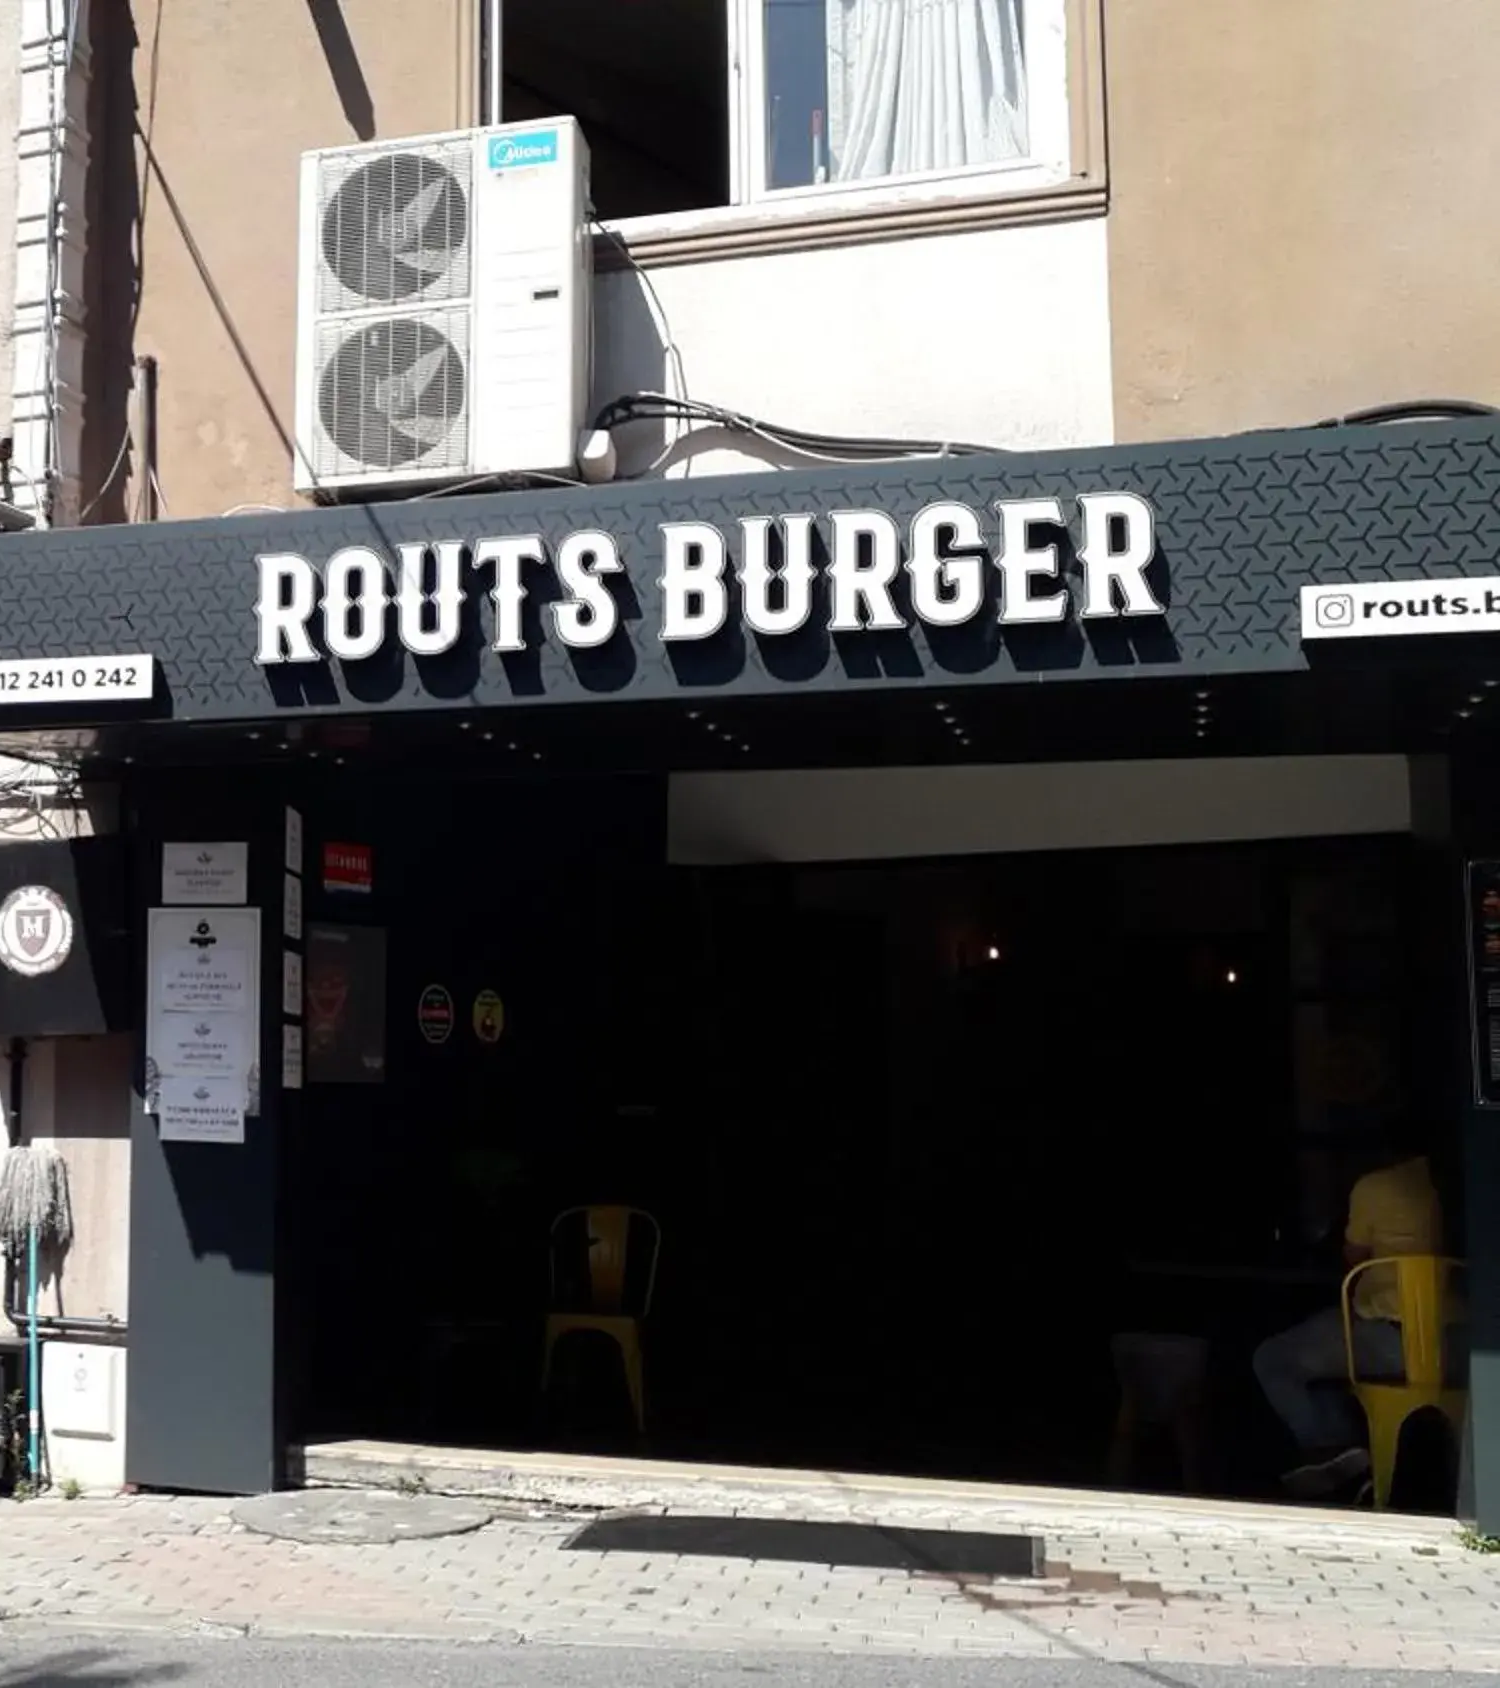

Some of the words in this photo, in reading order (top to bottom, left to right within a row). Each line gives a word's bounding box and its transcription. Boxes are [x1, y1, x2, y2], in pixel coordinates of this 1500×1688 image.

[253, 528, 625, 666] ROUTS
[655, 490, 1167, 644] BURGER
[27, 669, 64, 690] 241
[71, 668, 87, 688] 0
[94, 666, 138, 687] 242
